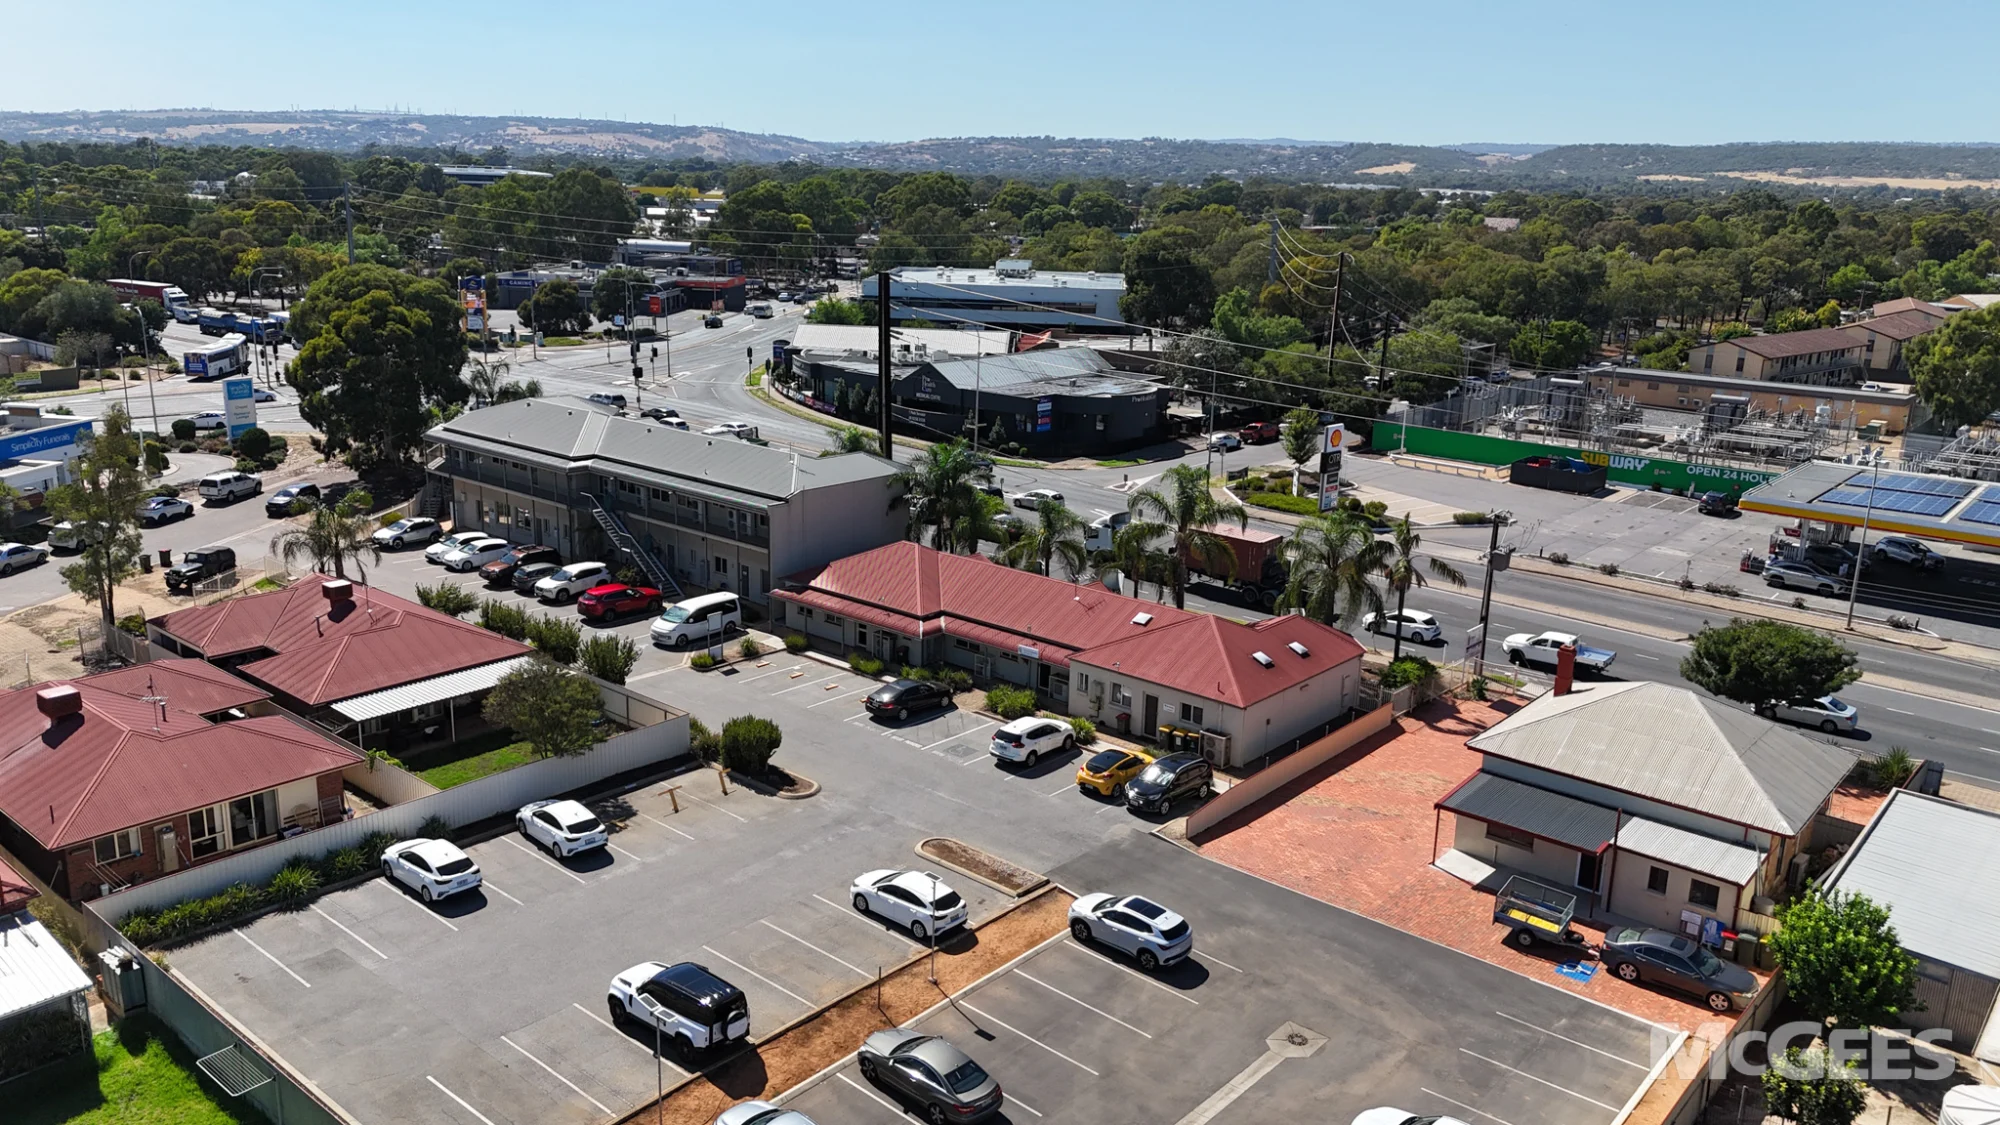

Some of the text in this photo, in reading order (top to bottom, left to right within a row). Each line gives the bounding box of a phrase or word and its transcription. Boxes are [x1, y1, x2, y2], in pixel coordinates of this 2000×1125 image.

[11, 433, 71, 453] Simplicity Funerals
[1581, 451, 1650, 471] SUBWAY
[1686, 465, 1720, 478] OPEN
[1722, 469, 1738, 479] 24
